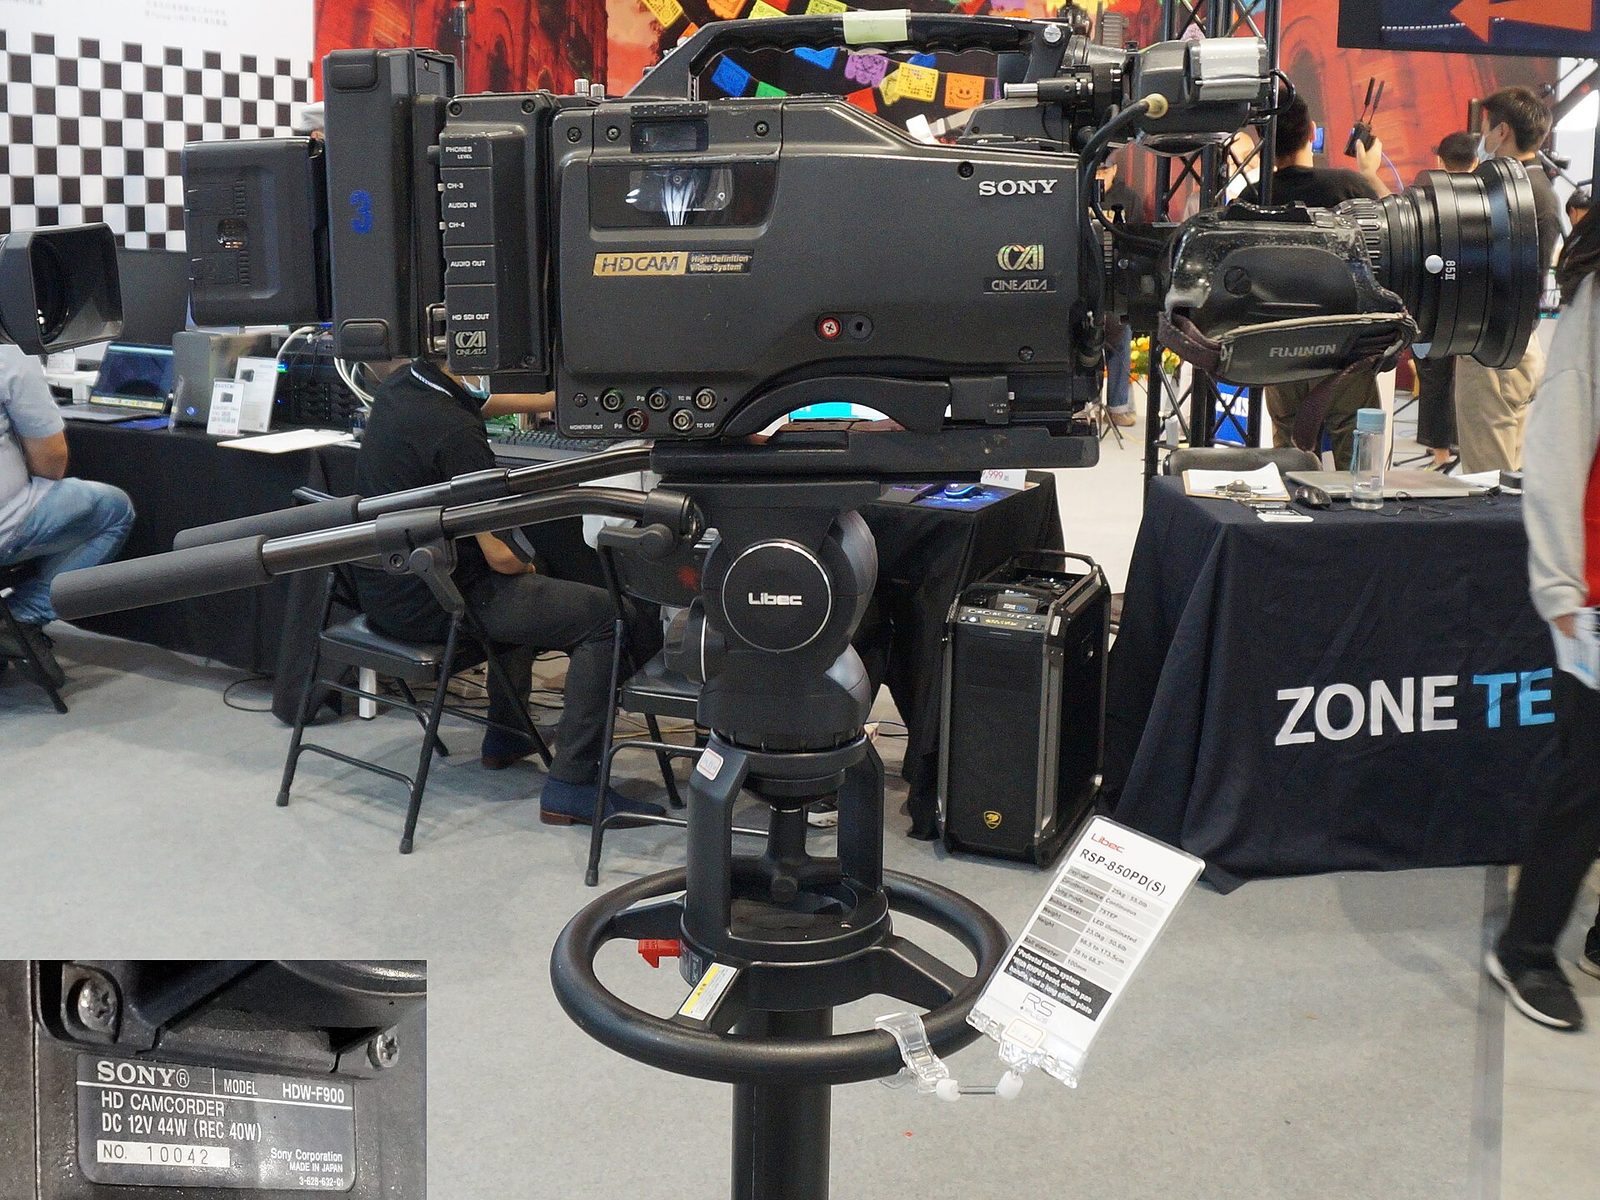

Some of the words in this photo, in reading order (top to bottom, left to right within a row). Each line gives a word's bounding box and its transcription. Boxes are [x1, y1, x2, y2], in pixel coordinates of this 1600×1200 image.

[979, 179, 1058, 196] SONY
[350, 190, 372, 234] 3
[601, 255, 679, 272] HDCAM
[689, 263, 712, 272] Video
[712, 263, 742, 272] System
[690, 254, 710, 264] High
[710, 253, 749, 262] Definition
[991, 279, 1047, 291] CINEALTA
[1269, 344, 1337, 358] FUJINON
[748, 592, 803, 606] Libec
[1275, 675, 1458, 746] ZONE
[1090, 833, 1125, 853] Libec
[1079, 848, 1166, 896] RSP-850PD(S)
[1042, 962, 1060, 975] studio
[1059, 971, 1081, 986] system
[1028, 976, 1041, 986] and
[1076, 1002, 1092, 1014] plate
[1060, 982, 1080, 997] double
[1079, 992, 1092, 1003] pan
[1023, 992, 1056, 1017] RS
[223, 1078, 259, 1096] MODEL
[282, 1082, 345, 1104] HDW-F900
[101, 1090, 124, 1109] HD
[130, 1093, 225, 1117] CAMCORDER
[102, 1112, 122, 1133] DC
[128, 1114, 153, 1135] 12V
[158, 1117, 187, 1137] 44W
[194, 1118, 225, 1139] (REC
[229, 1122, 262, 1143] 40W)
[103, 1143, 128, 1160] NO.
[147, 1145, 209, 1165] 10042
[270, 1147, 293, 1162] Sony
[295, 1148, 343, 1162] Corporation
[289, 1162, 311, 1172] MADE
[312, 1163, 320, 1172] IN
[321, 1164, 343, 1173] JAPAN
[298, 1176, 344, 1187] 3-628-632-01
